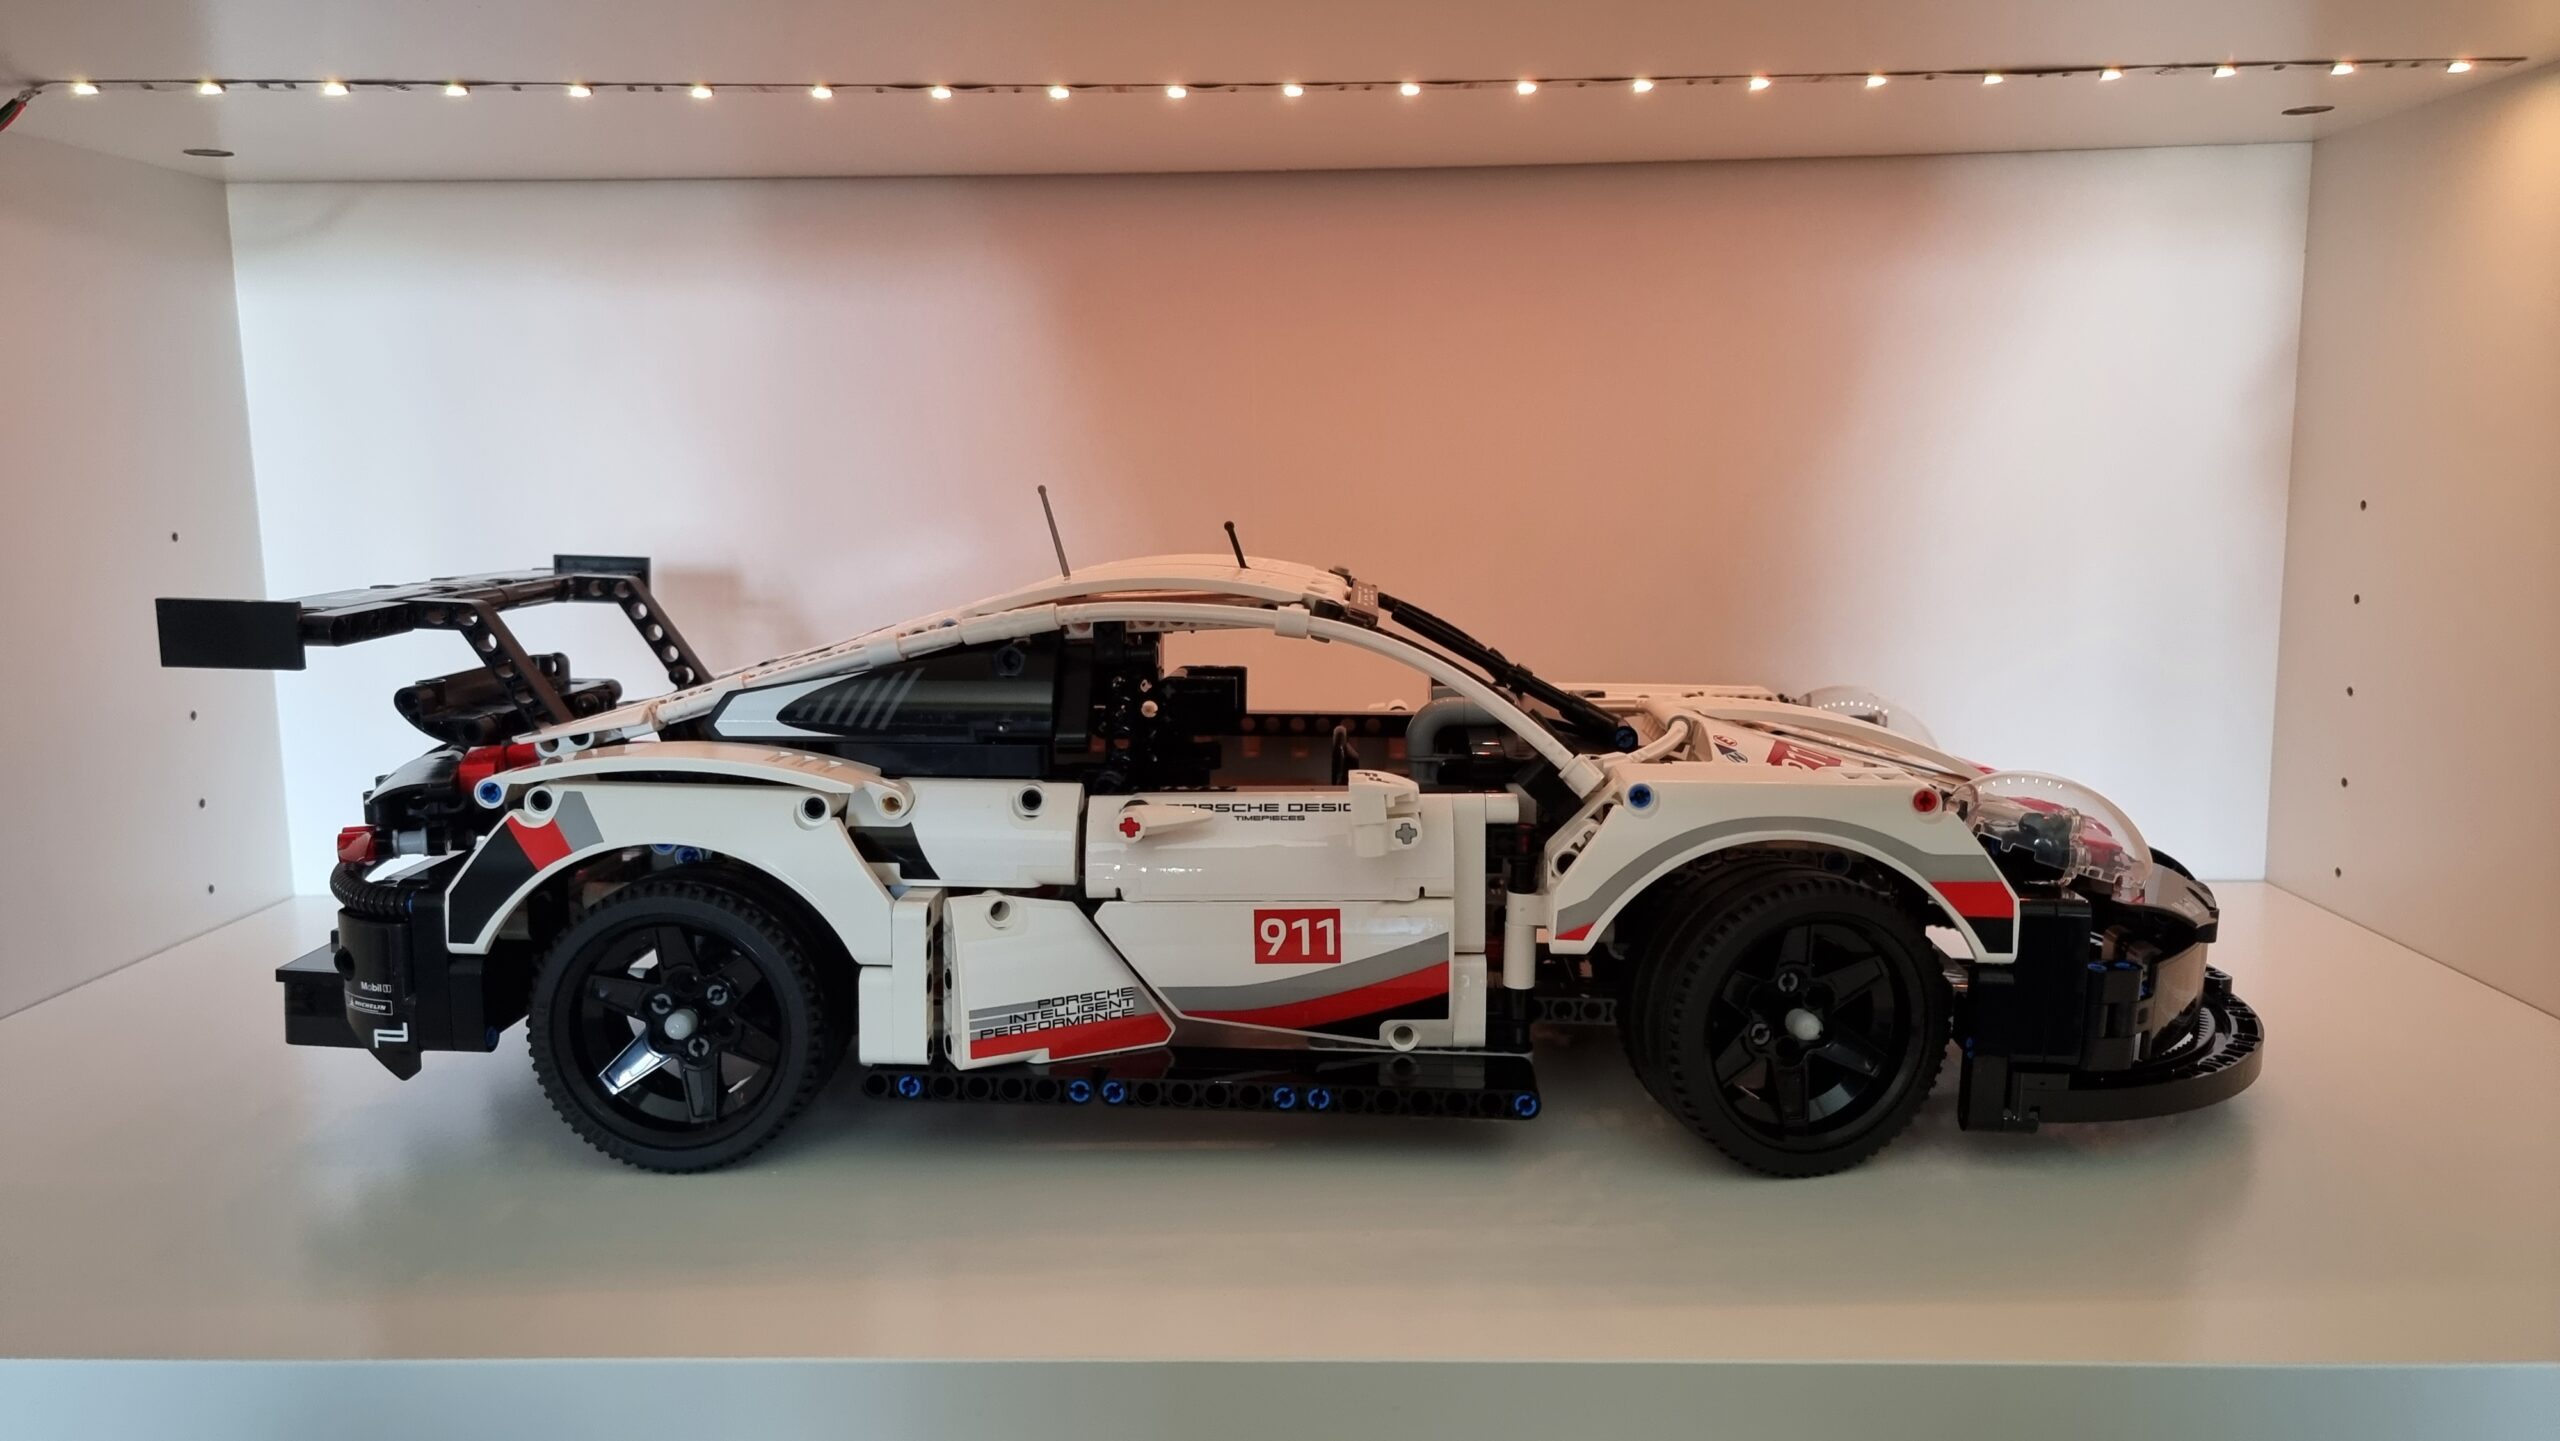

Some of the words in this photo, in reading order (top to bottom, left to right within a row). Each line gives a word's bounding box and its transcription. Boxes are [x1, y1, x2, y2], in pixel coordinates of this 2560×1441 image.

[1260, 917, 1335, 956] 911
[360, 981, 382, 993] Mobil
[1037, 986, 1135, 1009] PORSCHE
[354, 1000, 387, 1011] MICHELIN
[1009, 997, 1135, 1024] INTELLIGENT
[980, 1008, 1135, 1040] PERFORMANCE
